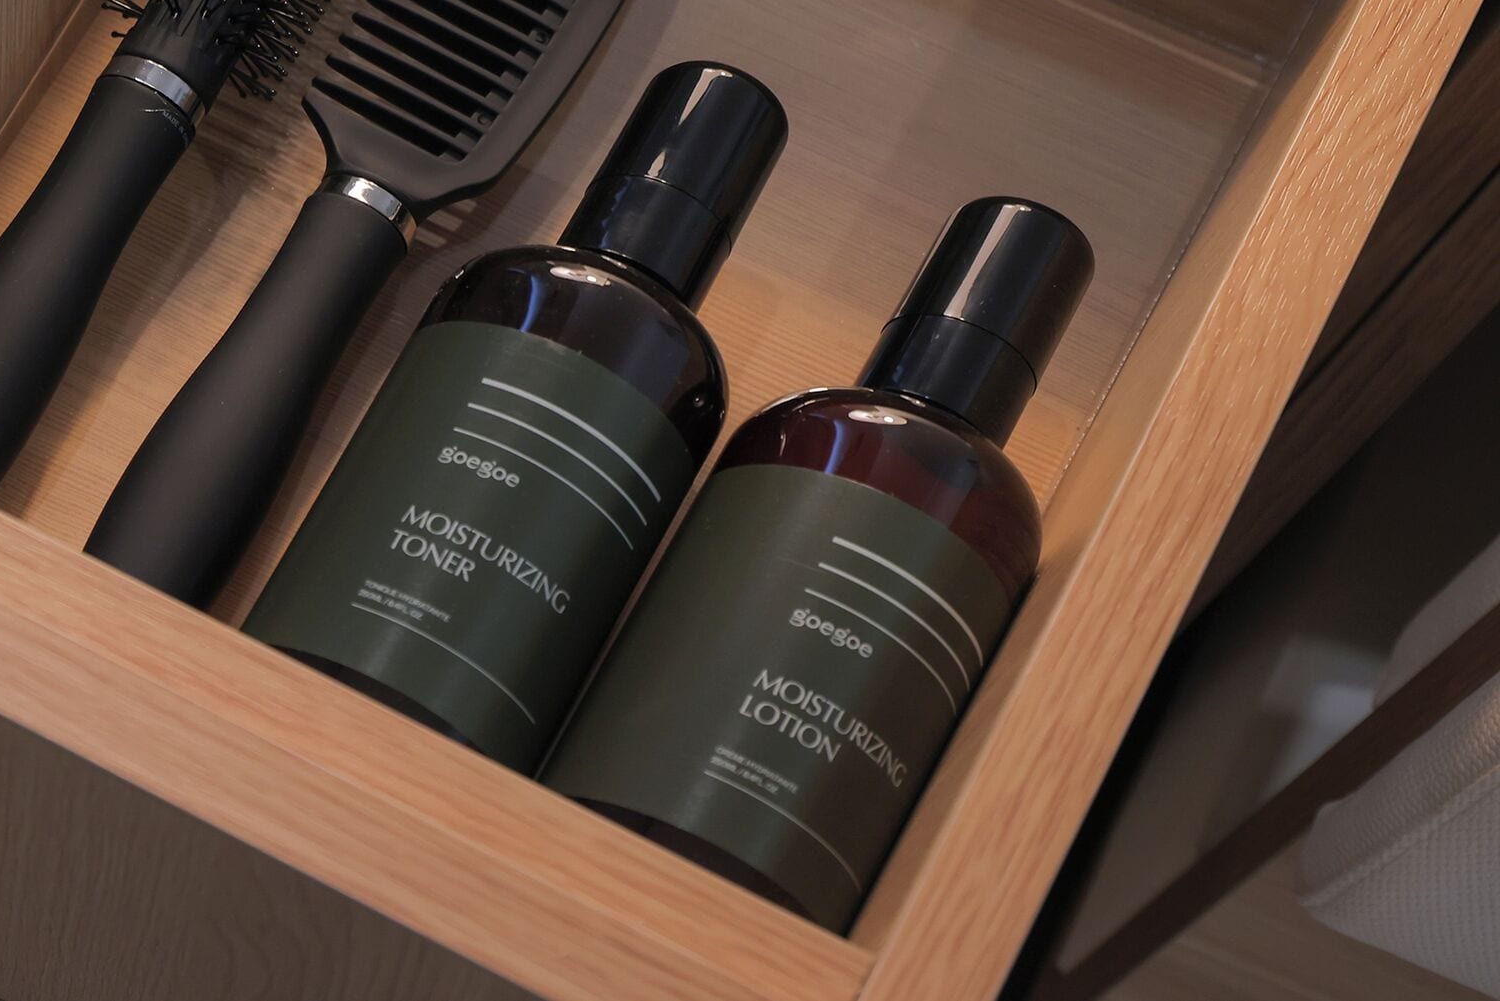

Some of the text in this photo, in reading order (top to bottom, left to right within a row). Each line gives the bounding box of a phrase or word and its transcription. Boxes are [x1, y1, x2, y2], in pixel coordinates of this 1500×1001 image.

[437, 445, 520, 488] goegoe
[390, 529, 476, 582] TONER
[401, 505, 571, 614] MOISTURIZING
[789, 608, 873, 658] goegoe
[739, 694, 842, 763] LOTION
[753, 668, 908, 788] MOISTURIZING
